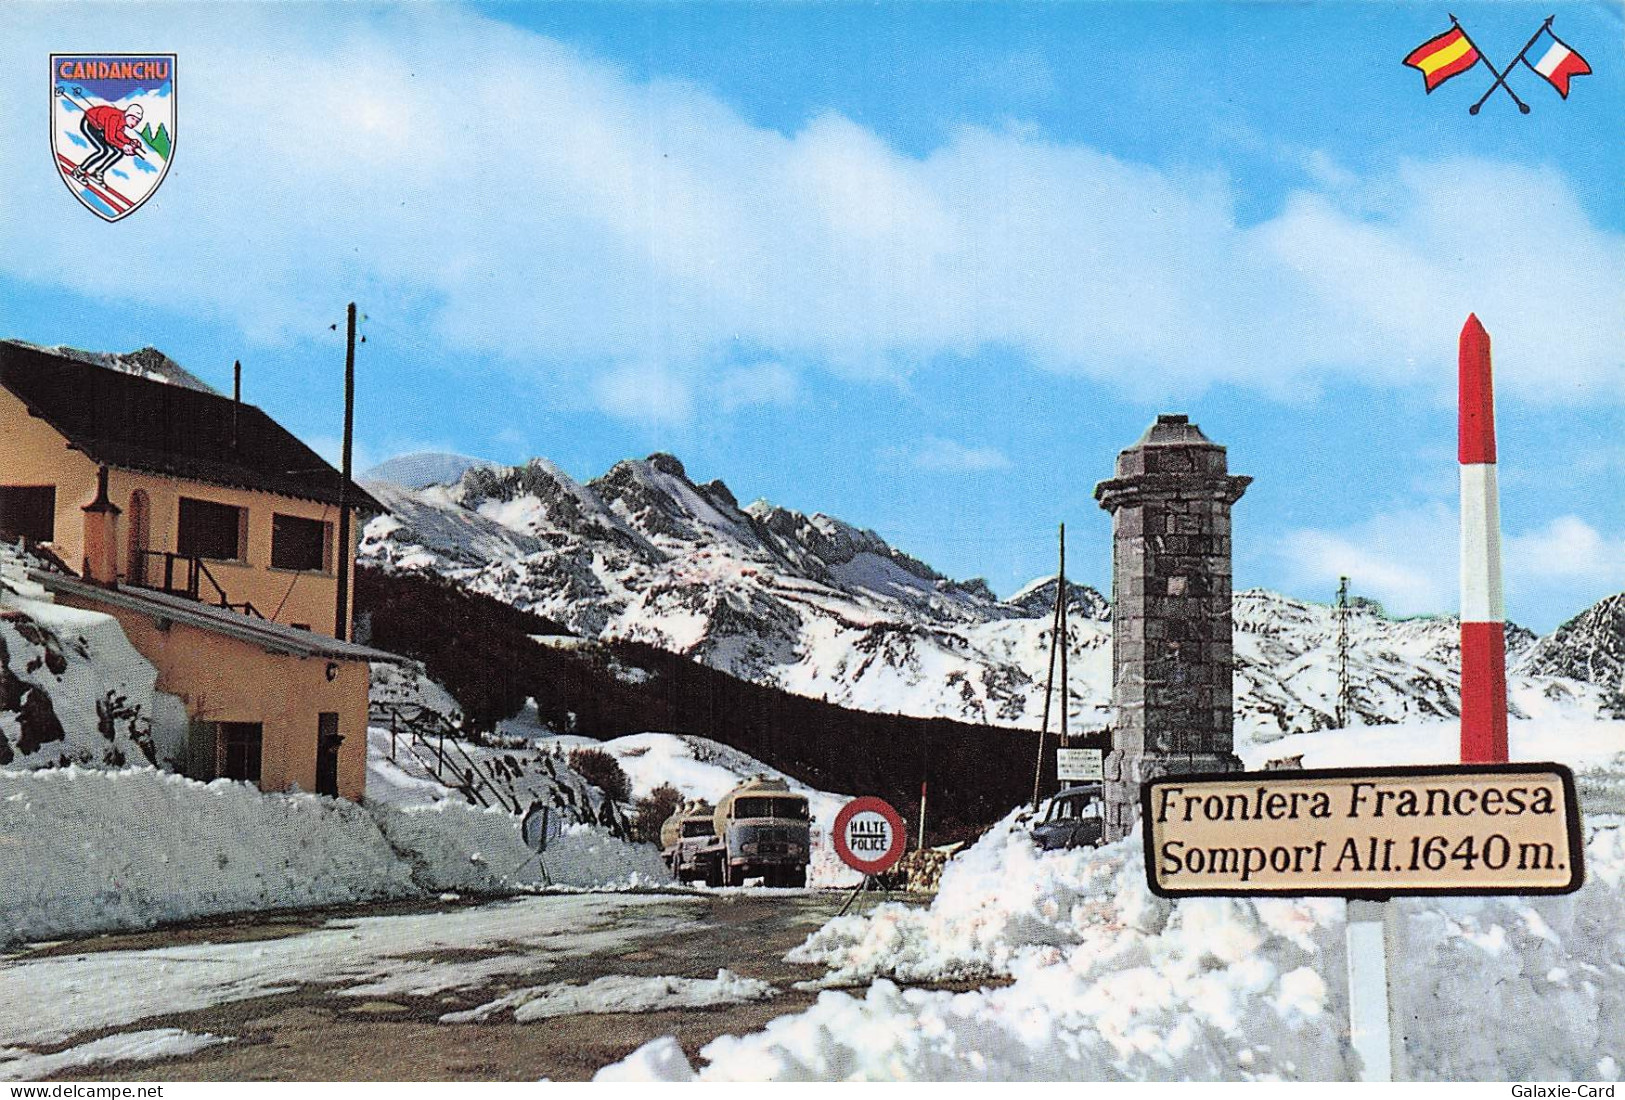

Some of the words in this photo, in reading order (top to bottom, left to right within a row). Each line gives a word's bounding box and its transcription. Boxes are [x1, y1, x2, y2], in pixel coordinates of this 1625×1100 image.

[1157, 785, 1333, 822] Frontera
[1345, 782, 1557, 818] Francesa
[850, 820, 887, 833] HALTE
[851, 838, 887, 851] POLICE
[1160, 840, 1327, 881] Somport
